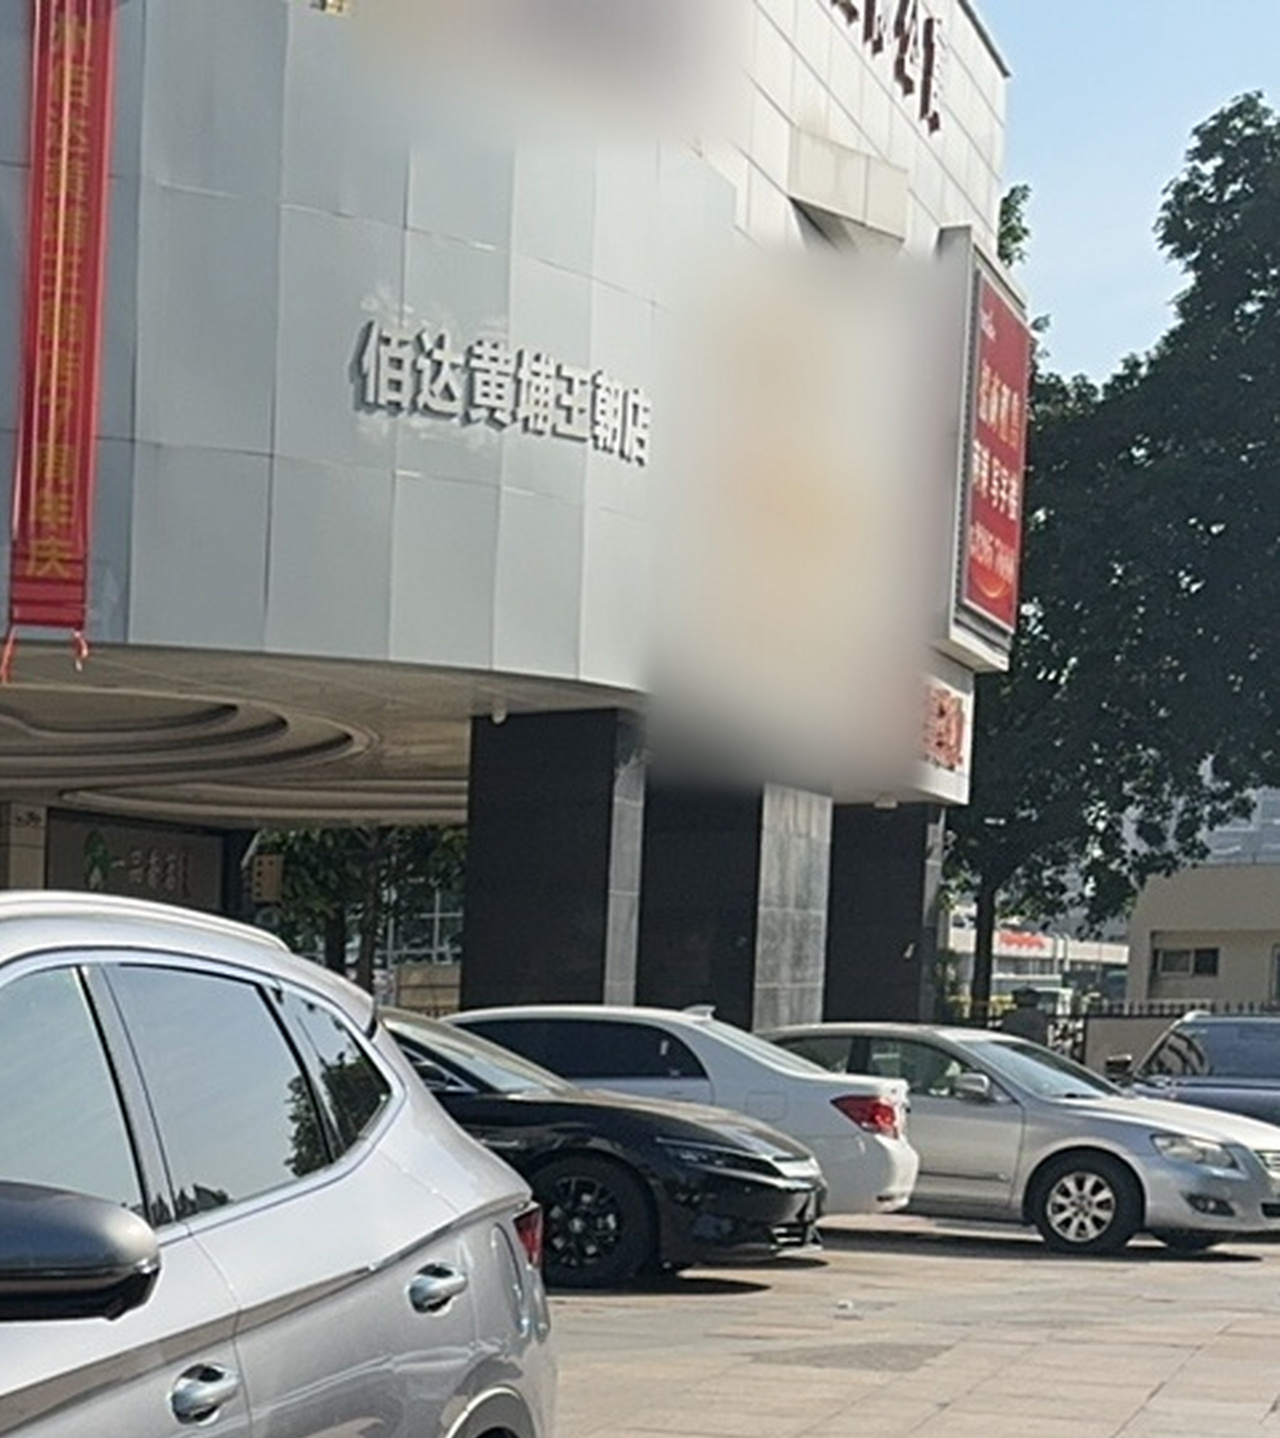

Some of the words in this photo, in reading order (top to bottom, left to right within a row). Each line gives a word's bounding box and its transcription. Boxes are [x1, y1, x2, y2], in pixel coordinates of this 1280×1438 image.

[354, 319, 653, 467] 佰达黄埔王朝店
